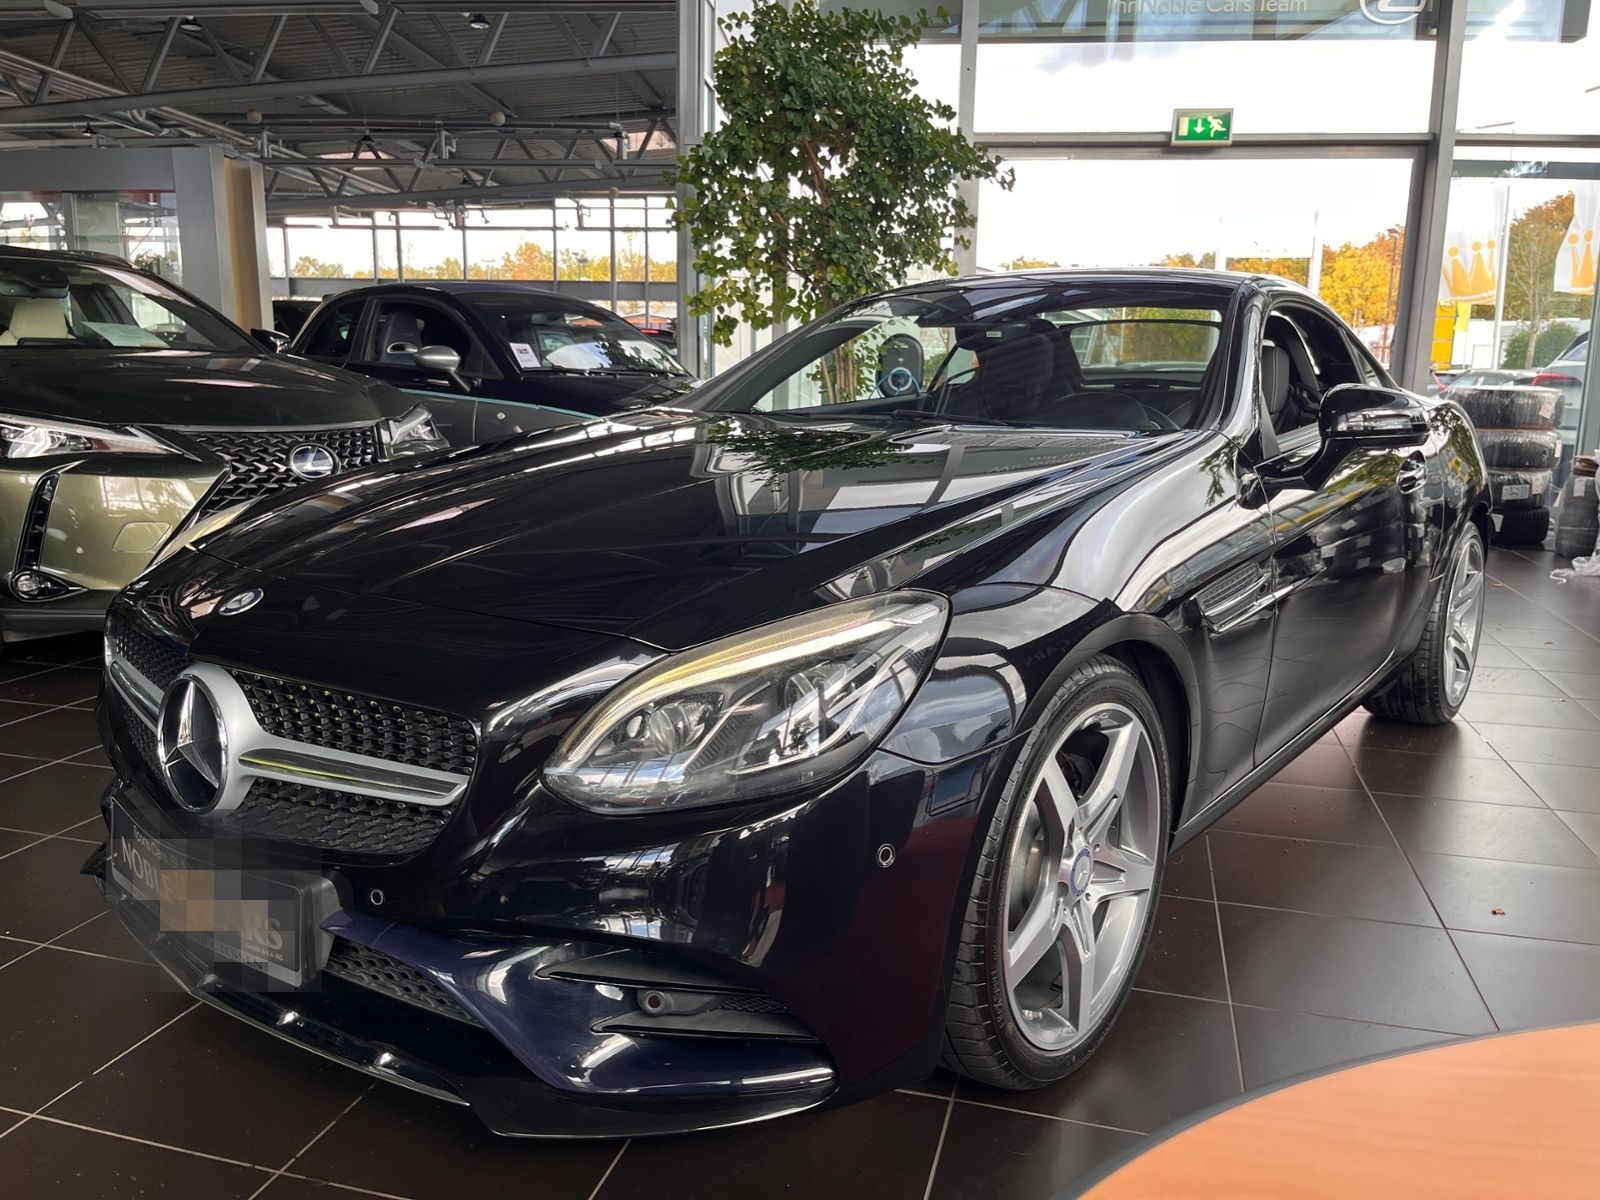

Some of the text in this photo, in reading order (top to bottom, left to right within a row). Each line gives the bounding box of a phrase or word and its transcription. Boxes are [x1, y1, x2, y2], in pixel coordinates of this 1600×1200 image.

[1139, 0, 1201, 15] Noble
[1206, 0, 1252, 13] Cars
[1258, 0, 1308, 13] Team
